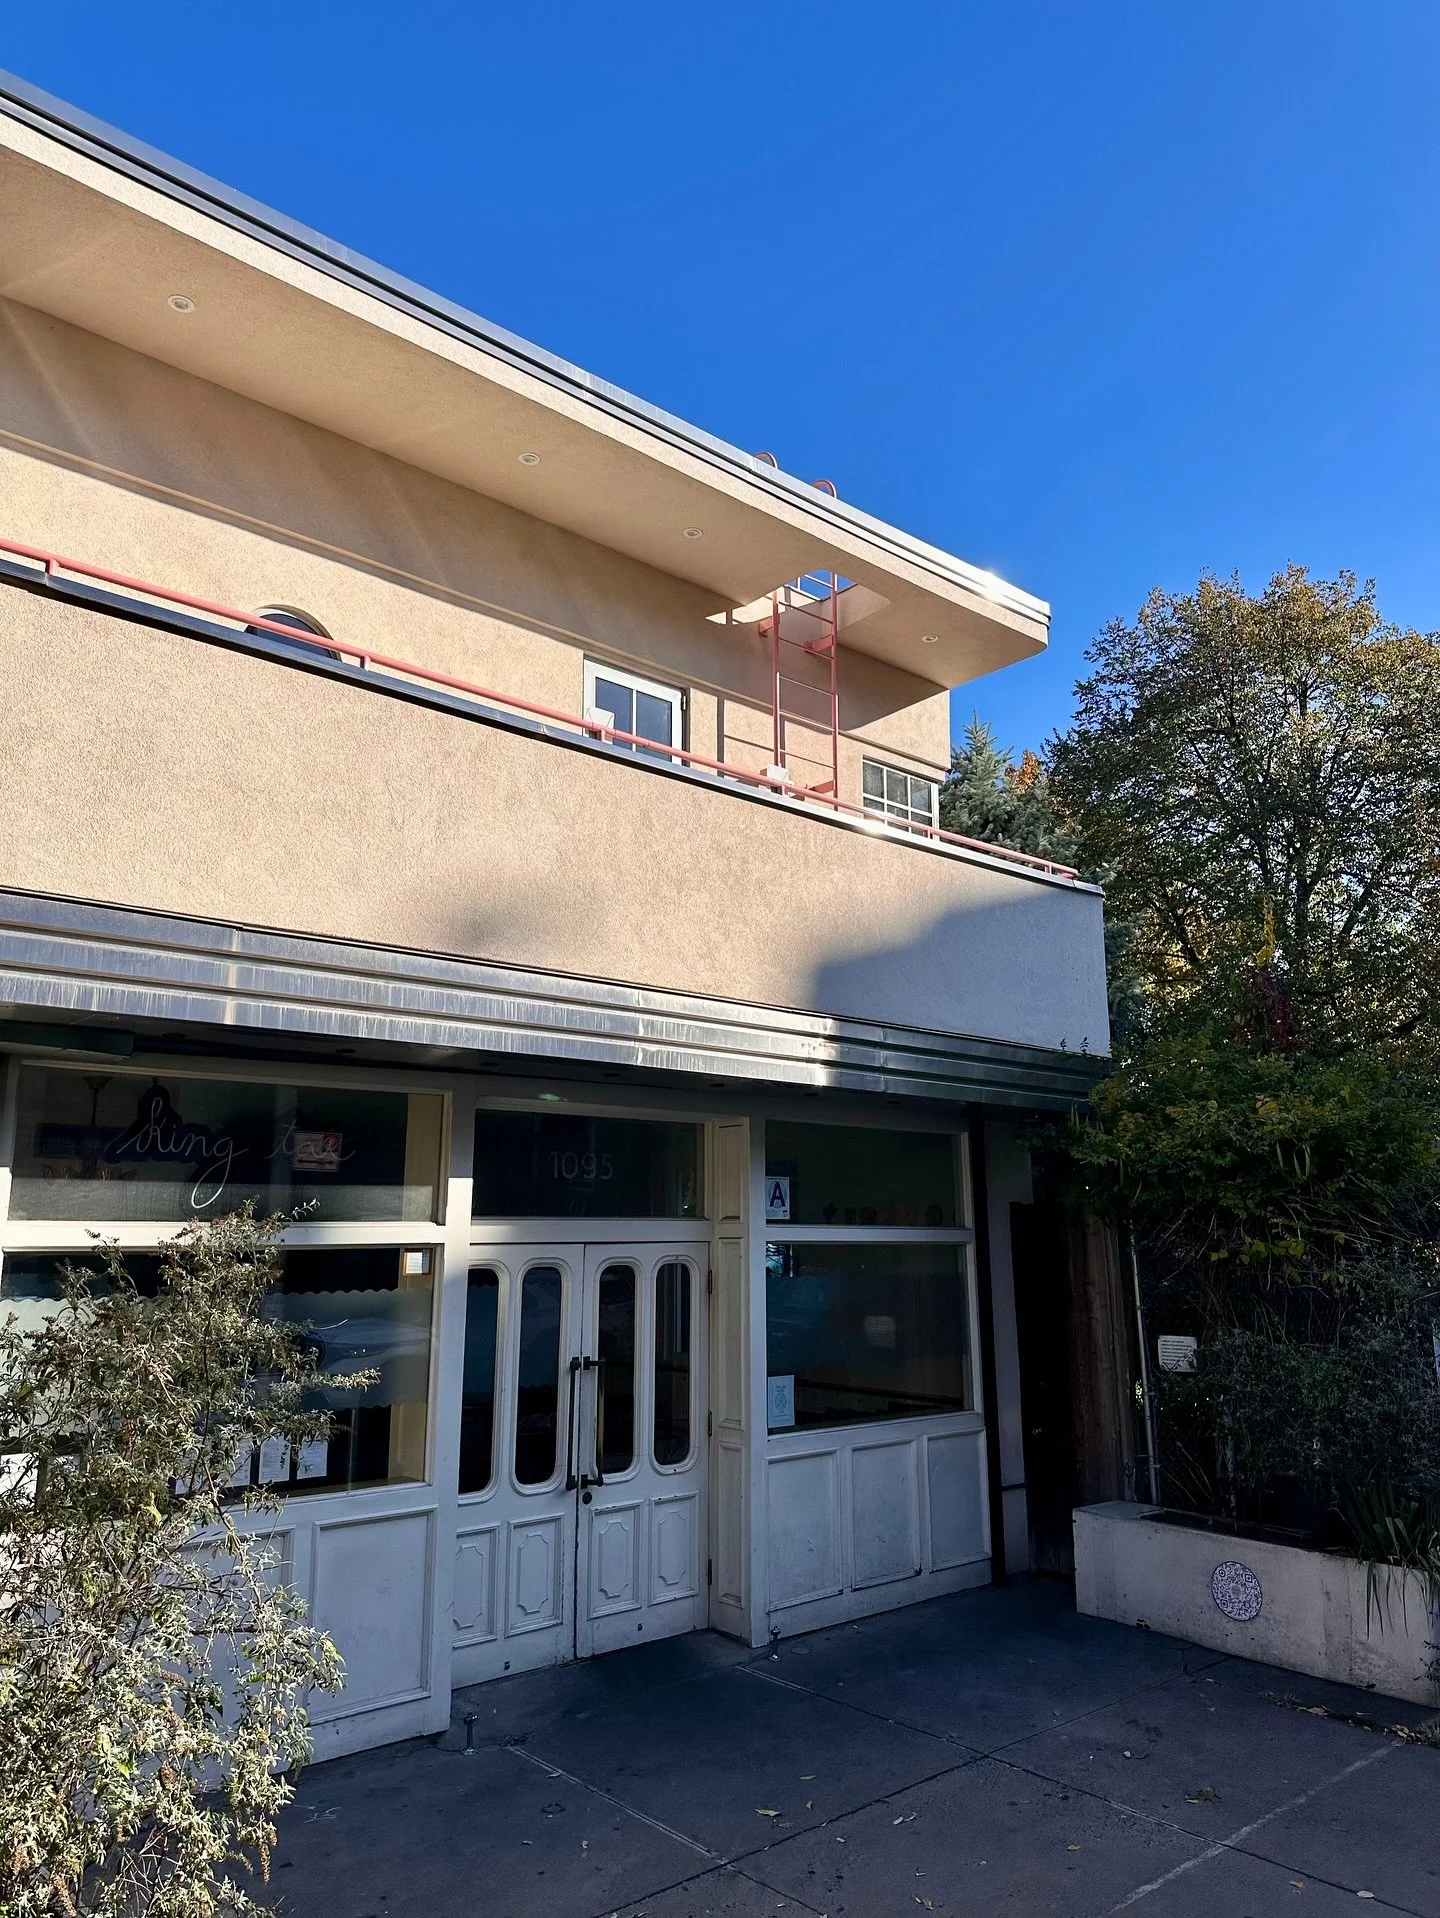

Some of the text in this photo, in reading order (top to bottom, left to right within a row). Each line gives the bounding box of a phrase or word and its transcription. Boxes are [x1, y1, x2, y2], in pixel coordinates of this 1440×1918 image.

[116, 1097, 250, 1208] king
[550, 1151, 613, 1180] 1095
[769, 1181, 786, 1207] A
